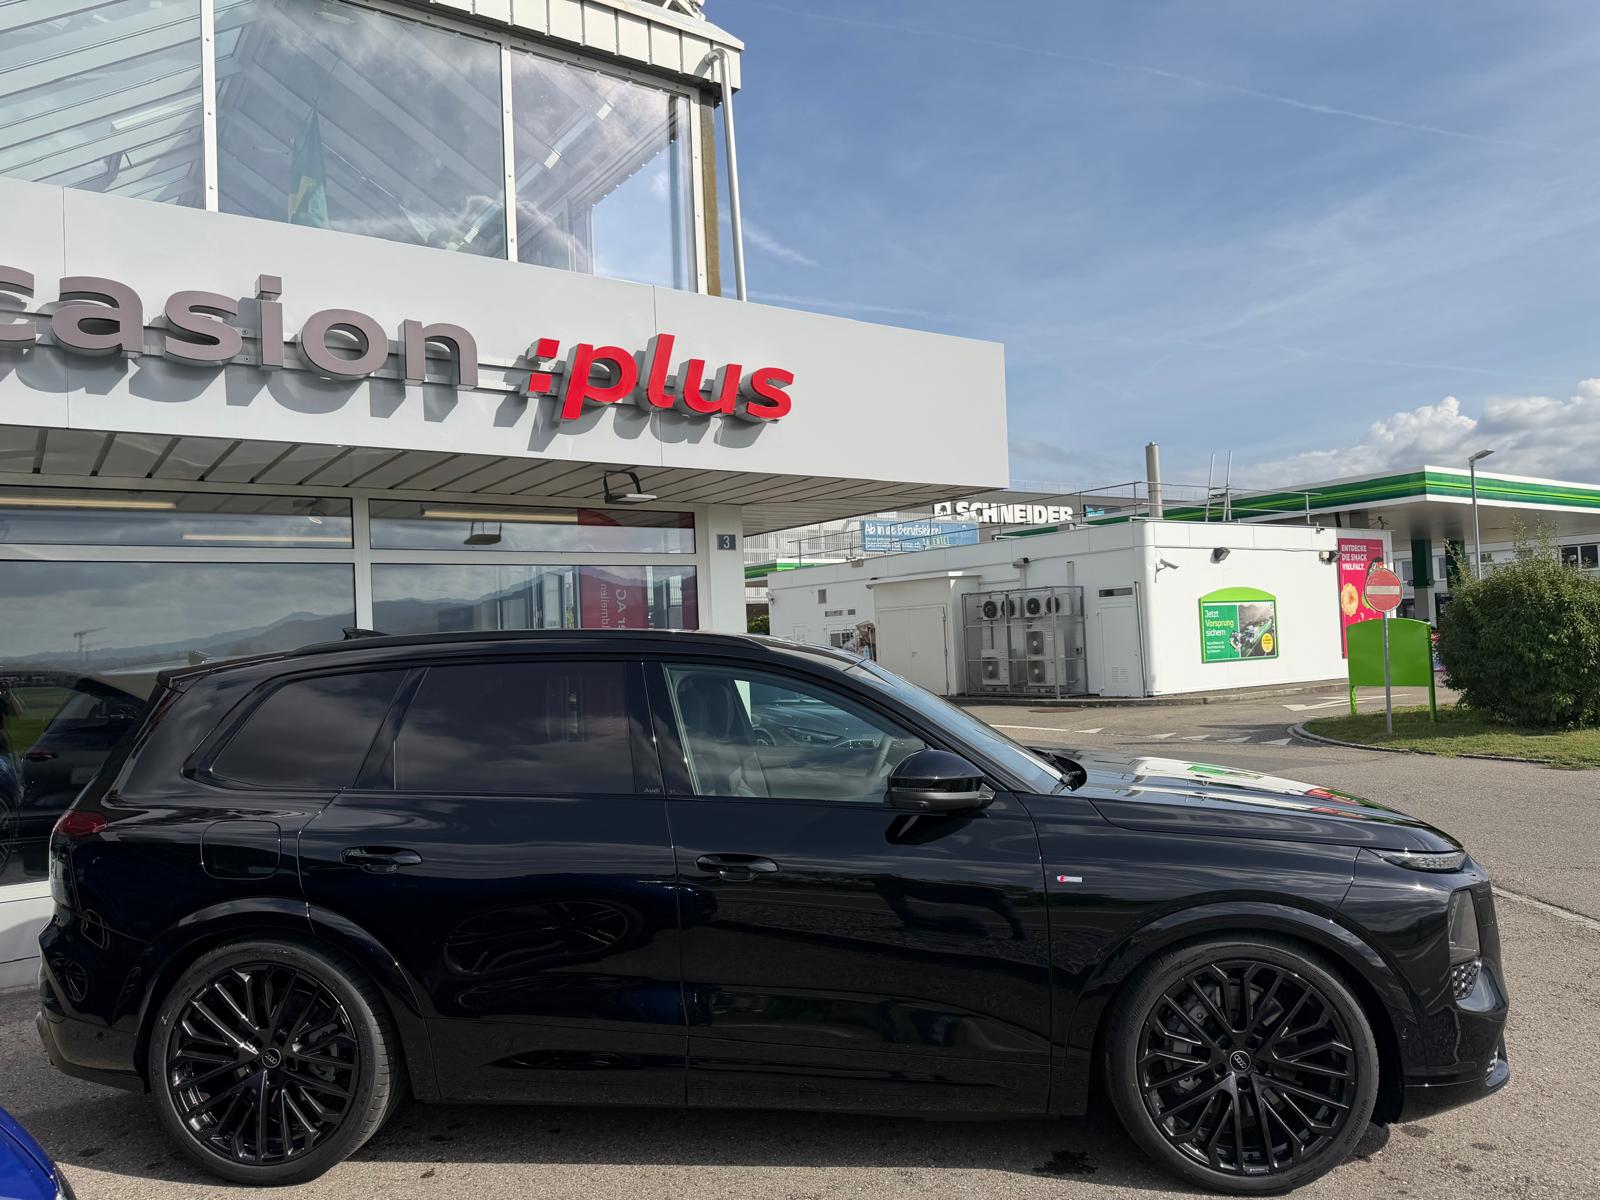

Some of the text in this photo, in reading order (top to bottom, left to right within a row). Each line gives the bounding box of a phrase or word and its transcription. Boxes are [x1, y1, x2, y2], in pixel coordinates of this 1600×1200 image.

[955, 501, 1074, 525] SCHNEIDER
[865, 523, 876, 535] Ab
[886, 524, 897, 535] de
[723, 535, 730, 548] 3
[1341, 553, 1351, 561] DIE
[1204, 610, 1219, 618] Jetzt
